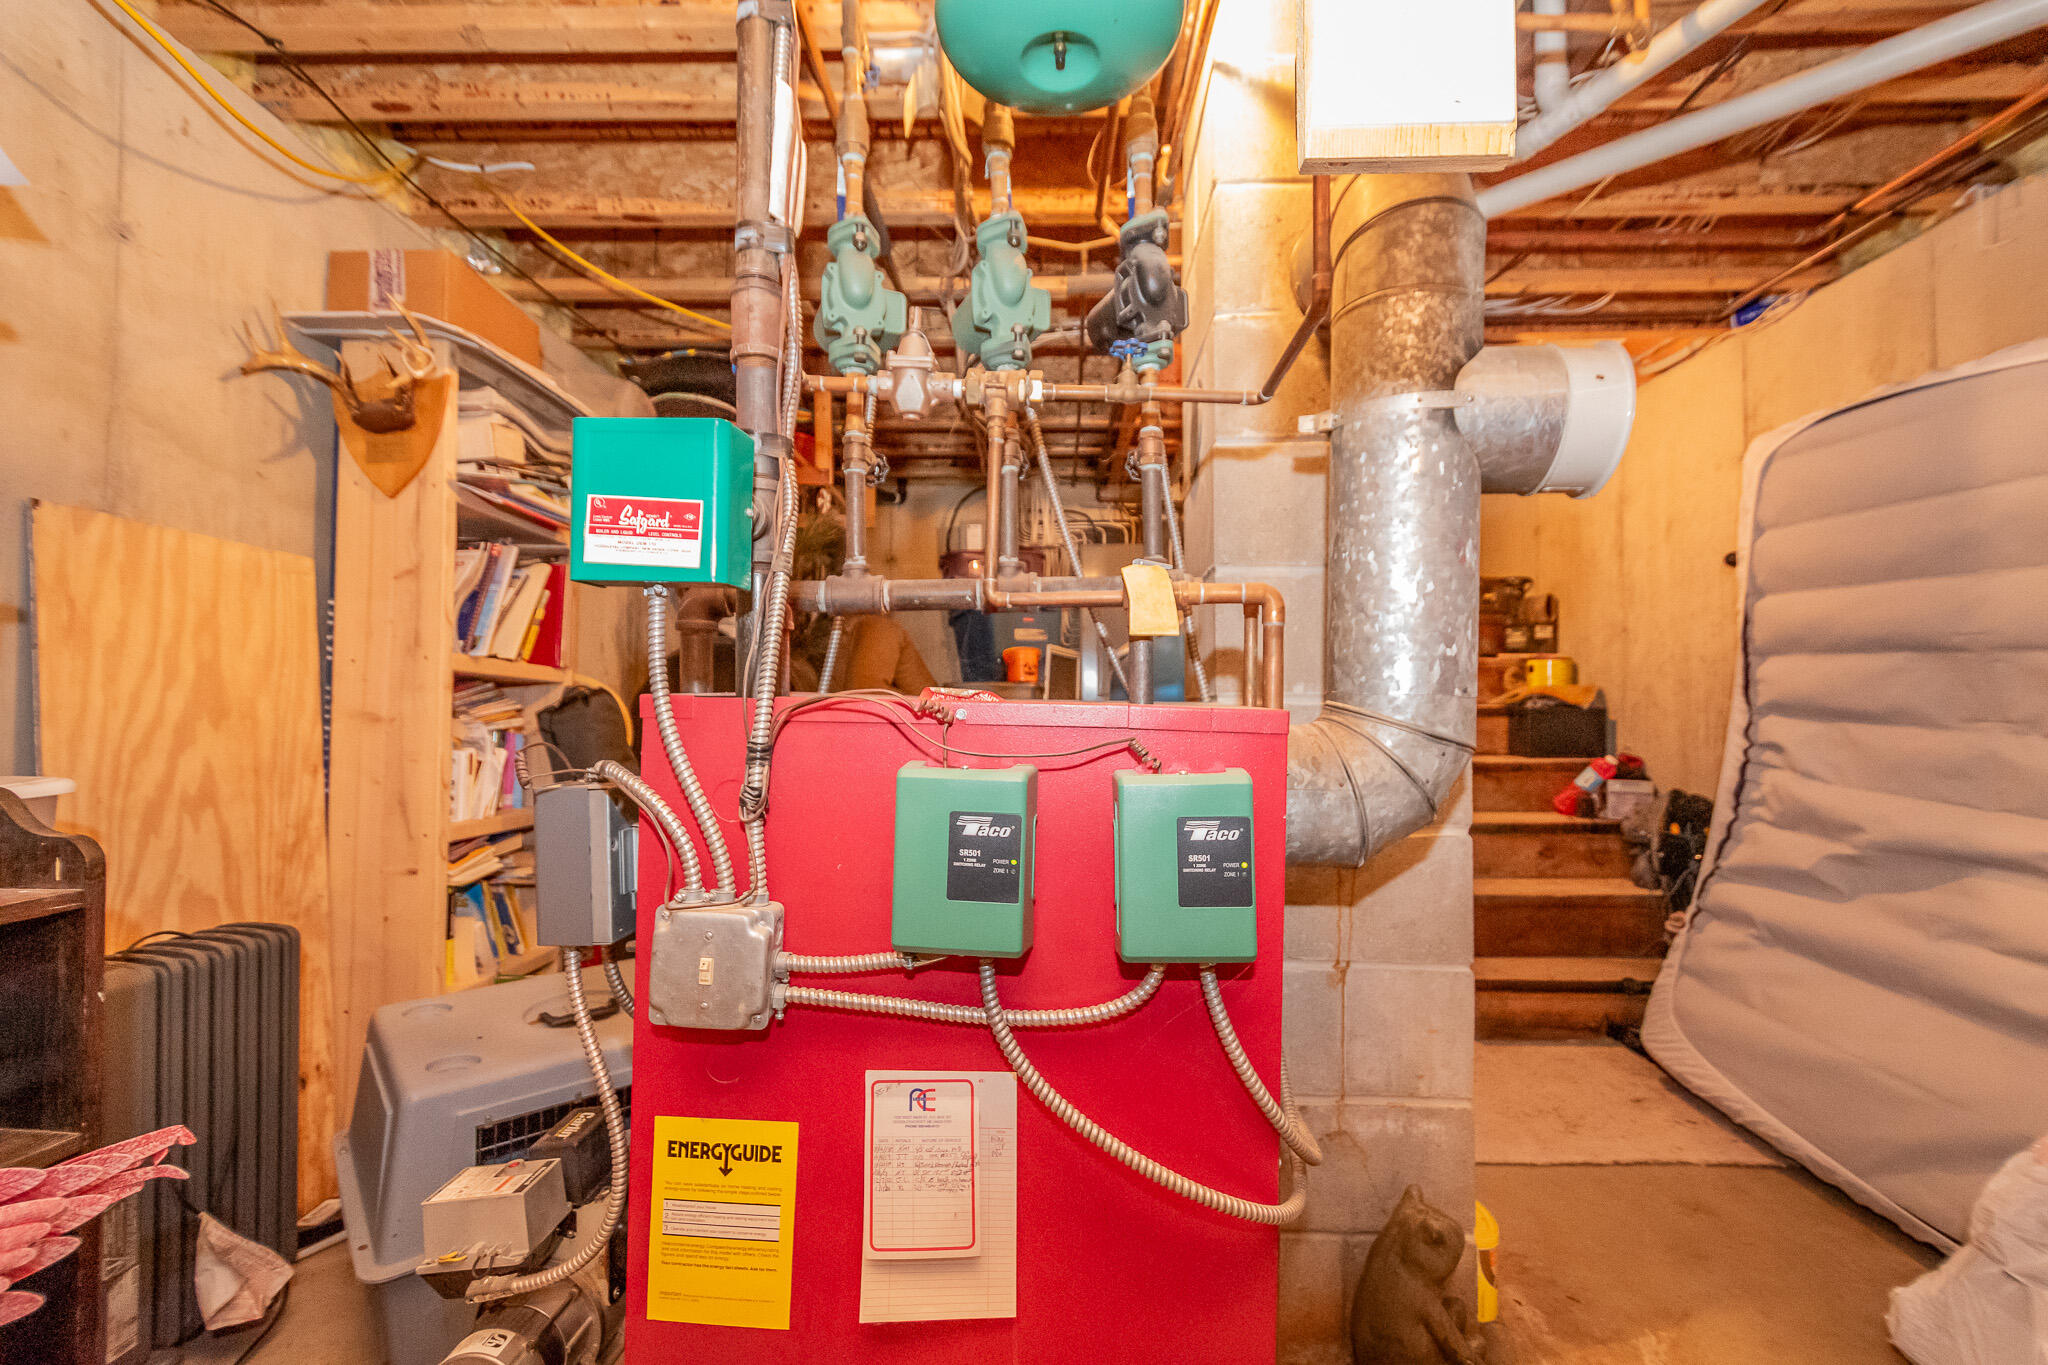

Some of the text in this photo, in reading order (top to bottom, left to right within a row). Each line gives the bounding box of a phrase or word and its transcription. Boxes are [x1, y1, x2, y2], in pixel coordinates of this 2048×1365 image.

[618, 504, 670, 534] Safgard
[956, 816, 1012, 838] Taco
[1184, 820, 1240, 840] Taco
[667, 1140, 782, 1163] ENERGYGUIDE
